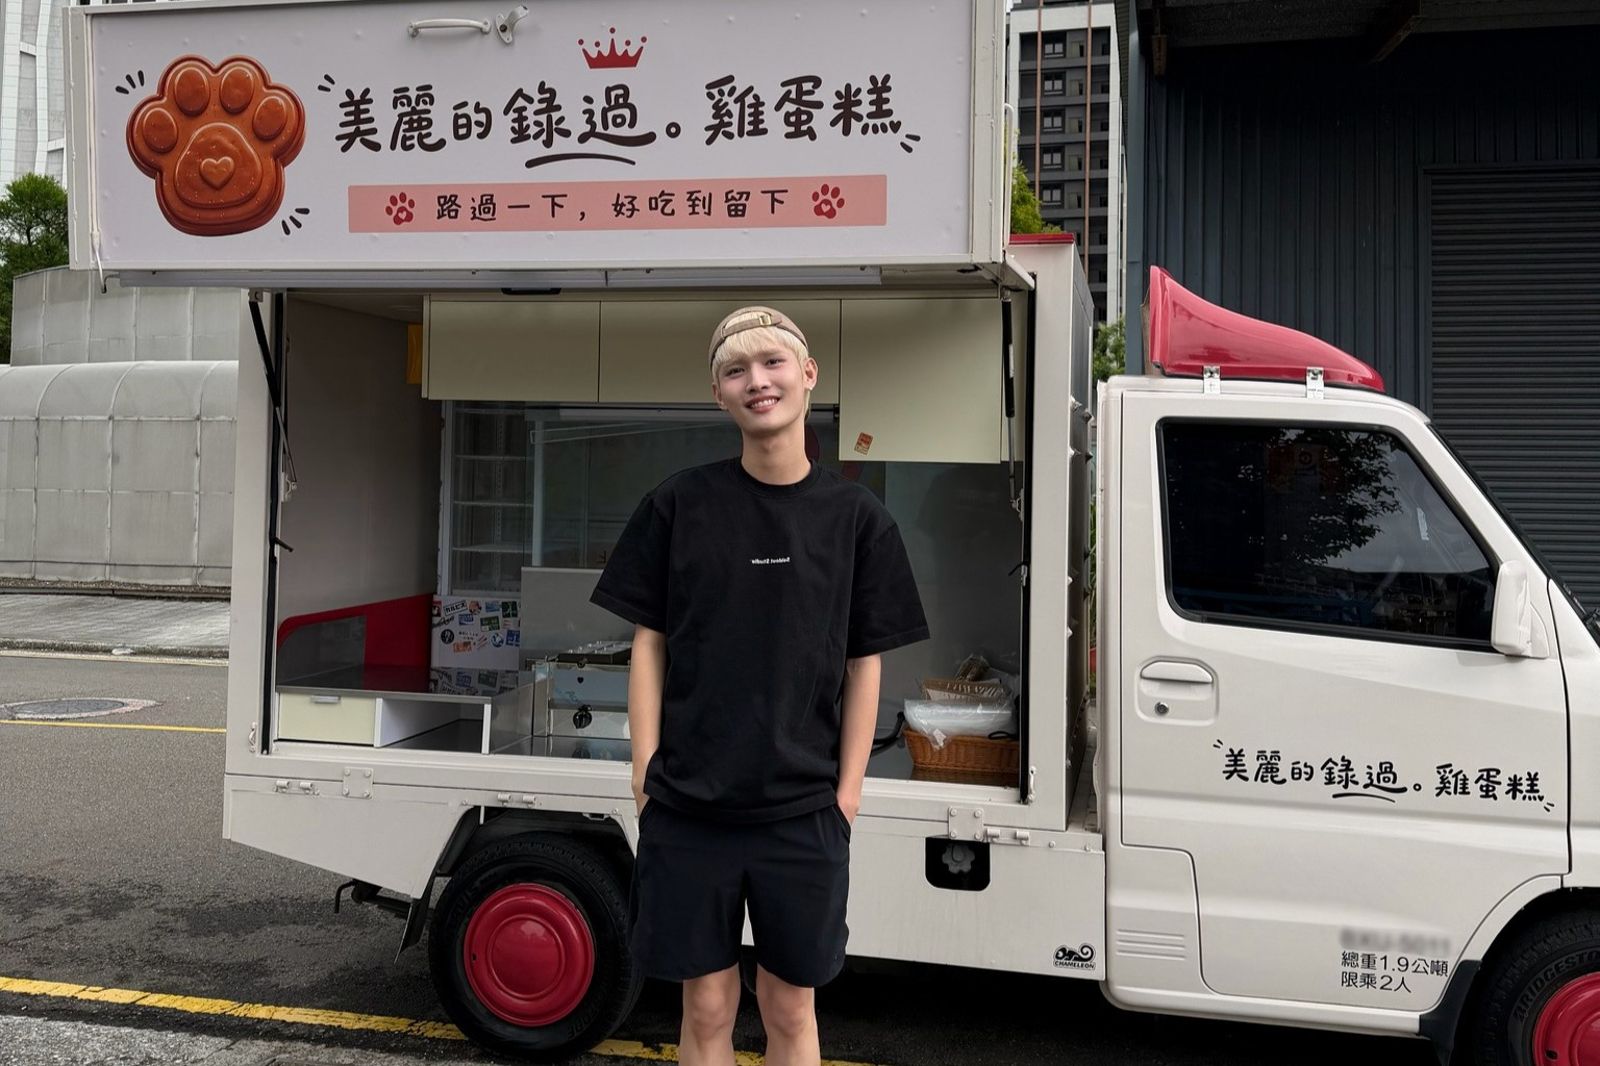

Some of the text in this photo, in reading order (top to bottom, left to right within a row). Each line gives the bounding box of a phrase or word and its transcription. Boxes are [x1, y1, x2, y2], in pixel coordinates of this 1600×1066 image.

[1054, 960, 1095, 969] CHAMELEON
[1341, 950, 1449, 977] 總重1.9公噸
[1341, 971, 1412, 994] 限乘2人
